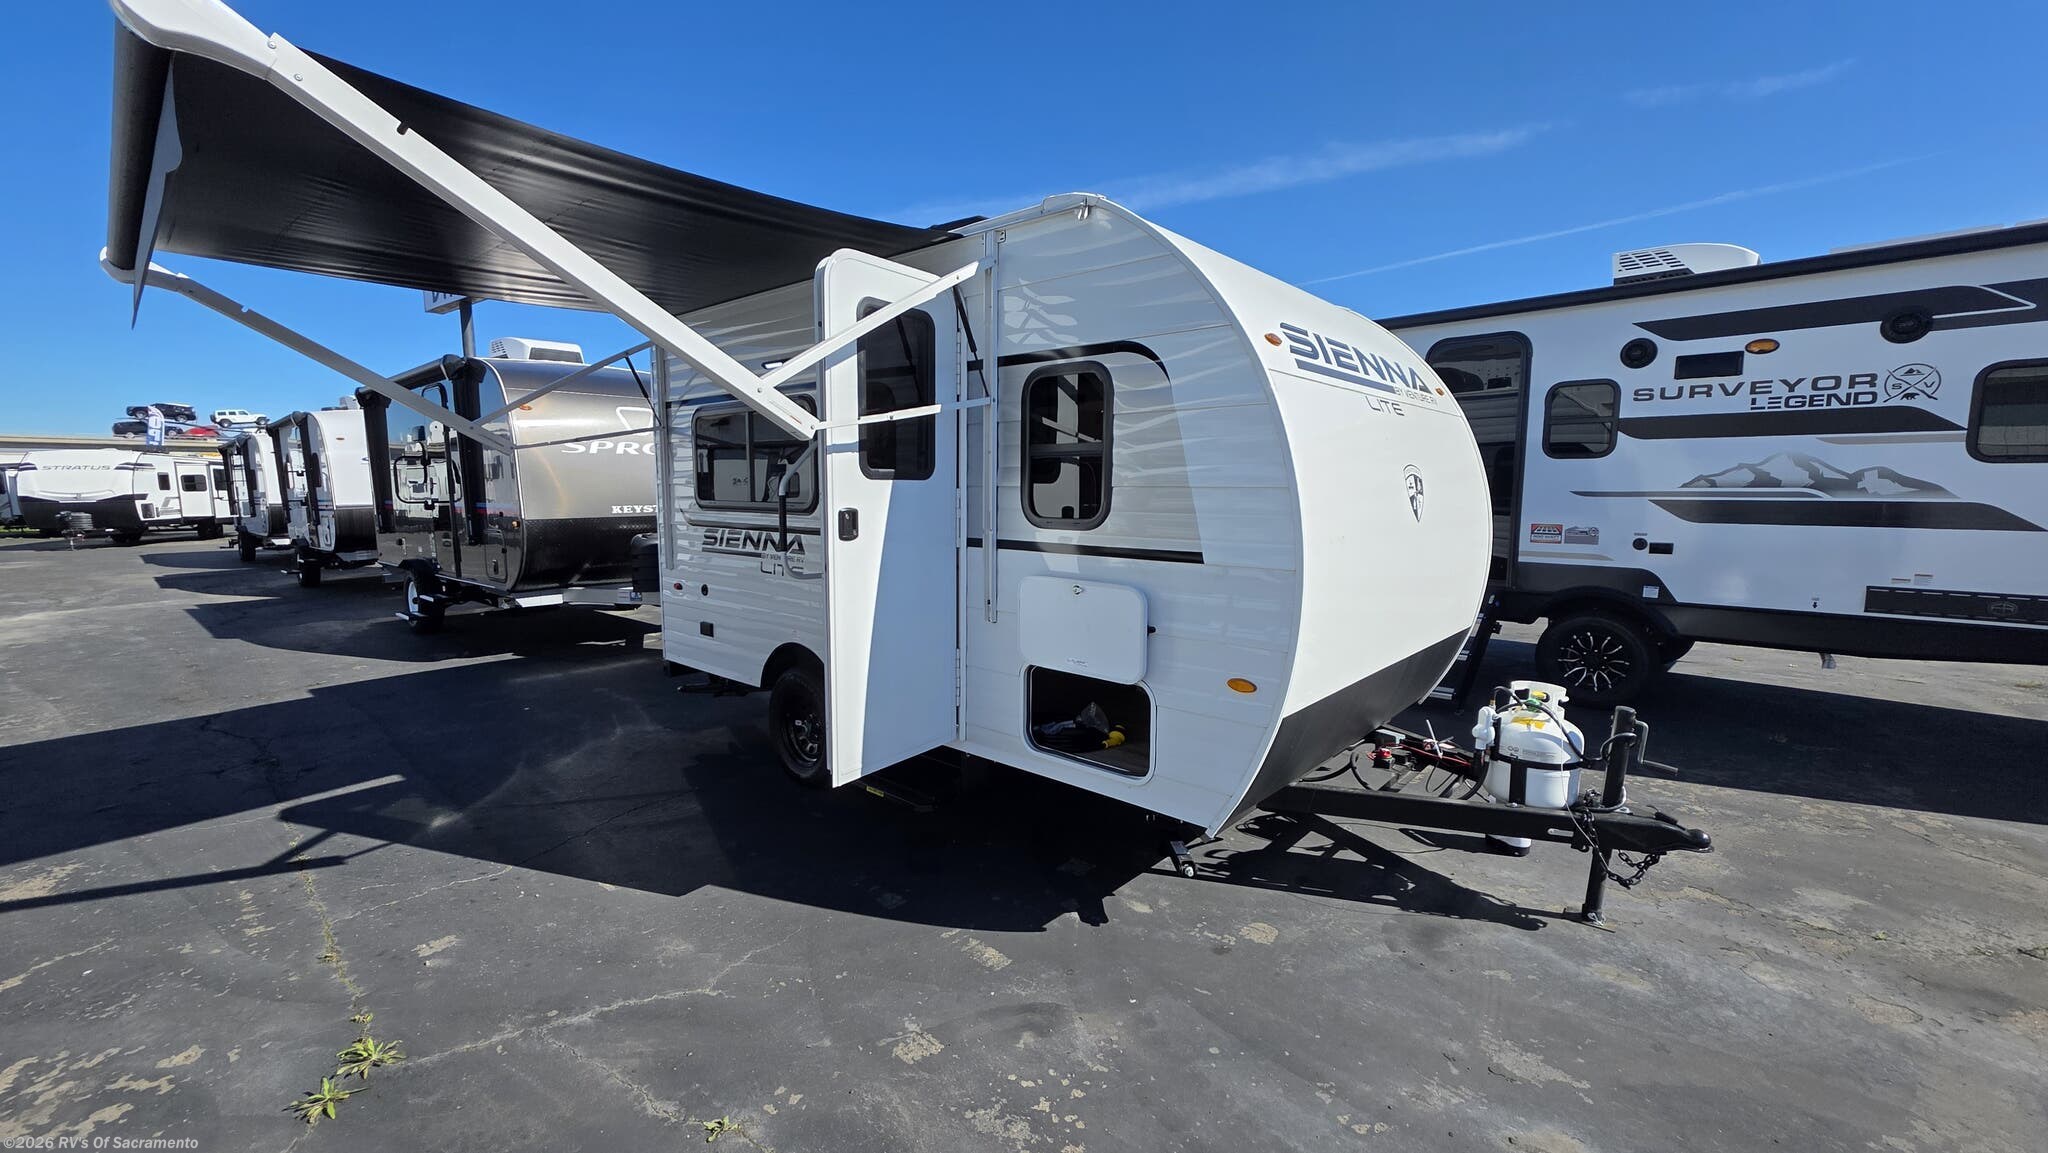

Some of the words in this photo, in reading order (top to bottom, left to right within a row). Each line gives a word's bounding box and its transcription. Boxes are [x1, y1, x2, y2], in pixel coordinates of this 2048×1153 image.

[1280, 322, 1432, 394] SIENNA
[1633, 373, 1878, 401] SURVEYOR
[1750, 391, 1878, 410] LEGEND
[1365, 396, 1405, 416] LITE
[702, 528, 806, 555] SIENNA
